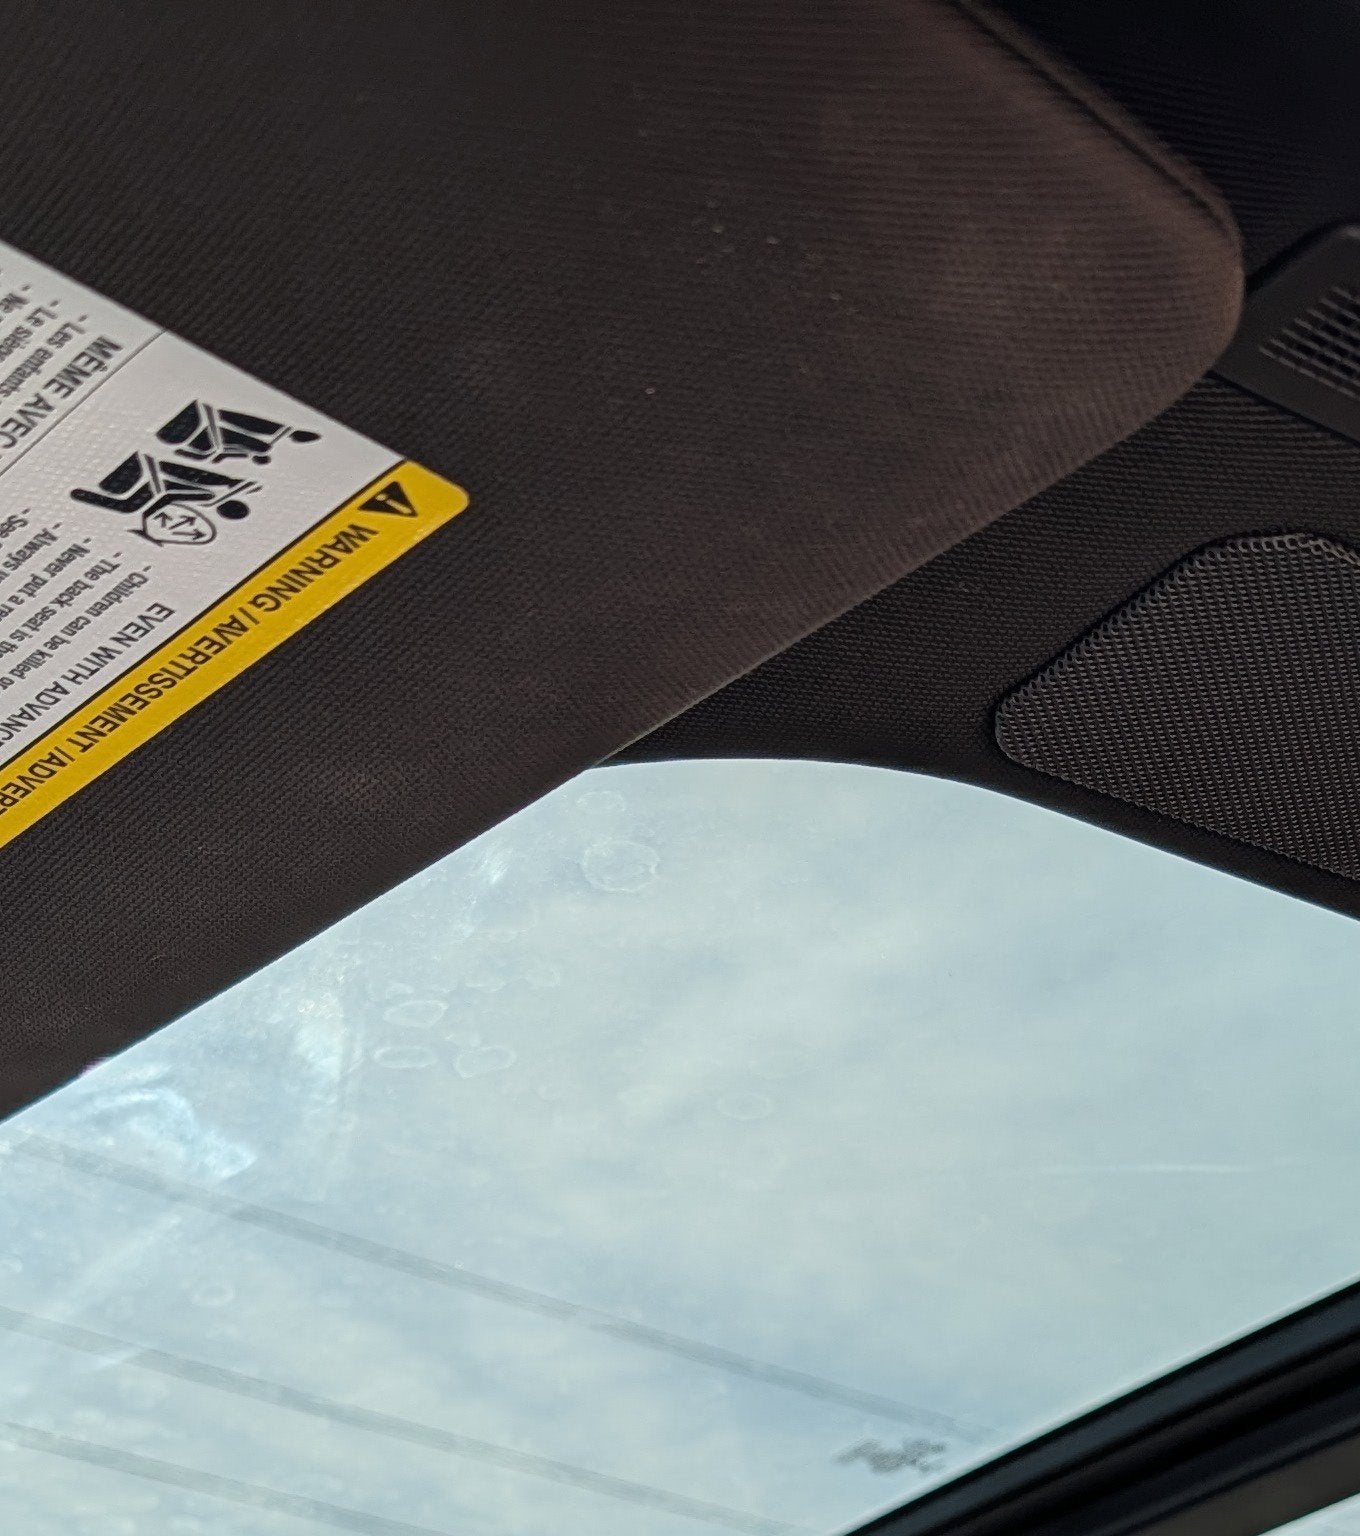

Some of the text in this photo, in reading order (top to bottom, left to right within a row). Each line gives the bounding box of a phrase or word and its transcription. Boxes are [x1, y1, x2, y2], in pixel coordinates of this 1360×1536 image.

[41, 335, 122, 399] MÊME
[0, 527, 58, 571] Always
[41, 542, 90, 578] Never
[82, 558, 121, 581] The
[246, 523, 378, 612] WARNING
[5, 594, 25, 605] a
[15, 572, 48, 598] put
[47, 578, 94, 608] back
[83, 571, 149, 617] Children
[19, 605, 57, 632] seat
[58, 615, 91, 637] can
[107, 601, 175, 648] EVEN
[7, 628, 33, 642] is
[41, 634, 71, 650] be
[6, 648, 53, 680] killed
[59, 645, 122, 685] WITH
[64, 606, 260, 753] /AVERTISSEMENT
